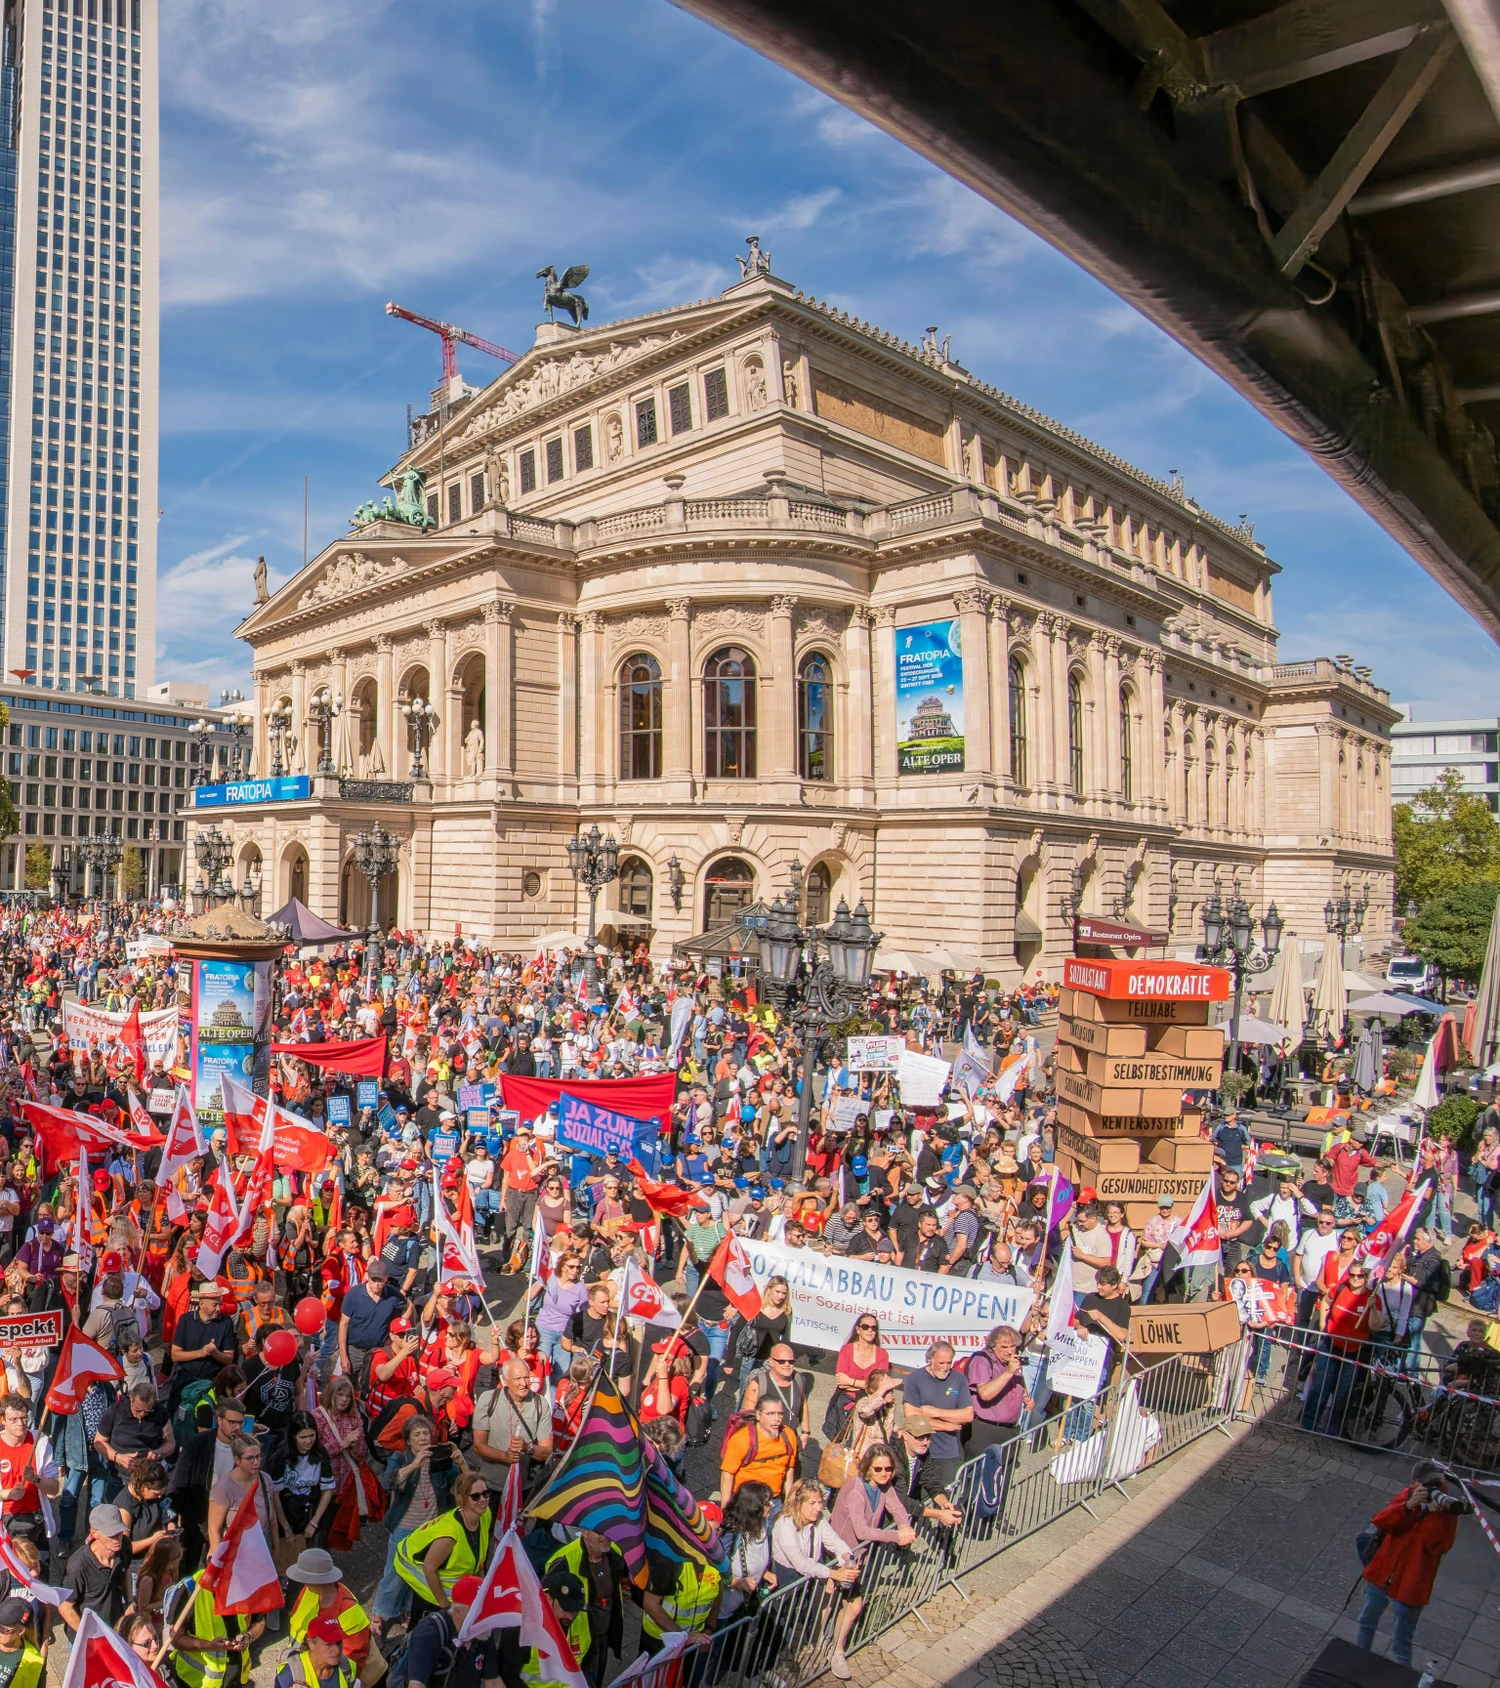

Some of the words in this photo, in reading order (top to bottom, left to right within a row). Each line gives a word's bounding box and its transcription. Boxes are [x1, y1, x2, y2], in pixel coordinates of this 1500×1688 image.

[900, 649, 951, 664] FRATOPIA
[902, 755, 931, 767] ALTE
[932, 753, 962, 765] OPER
[225, 783, 273, 801] FRATOPIA
[1092, 931, 1122, 940] Restaurant
[1124, 933, 1142, 941] Opéra
[205, 973, 240, 981] FRATOPIA
[1069, 964, 1107, 990] SOZIALSTAAT
[1128, 975, 1211, 996] DEMOKRATIE
[1128, 1002, 1176, 1018] TEILHABE
[200, 1028, 225, 1038] ALTE
[226, 1028, 252, 1039] OPER
[203, 1057, 238, 1065] FRATOPIA
[1113, 1064, 1213, 1082] SELBSTBESTIMMUNG
[197, 1110, 223, 1121] ALTE
[565, 1101, 591, 1124] JA
[594, 1107, 635, 1140] ZUM
[1101, 1115, 1184, 1131] RENTENSYSTEM
[750, 1252, 894, 1302] OZIALABBAU
[903, 1280, 1018, 1323] STOPPEN!
[816, 1294, 893, 1322] Sozialstaat
[897, 1310, 915, 1326] ist
[1140, 1319, 1183, 1345] LÖHNE
[35, 1337, 54, 1345] Arbeit
[881, 1333, 988, 1349] NVERZICHTBA
